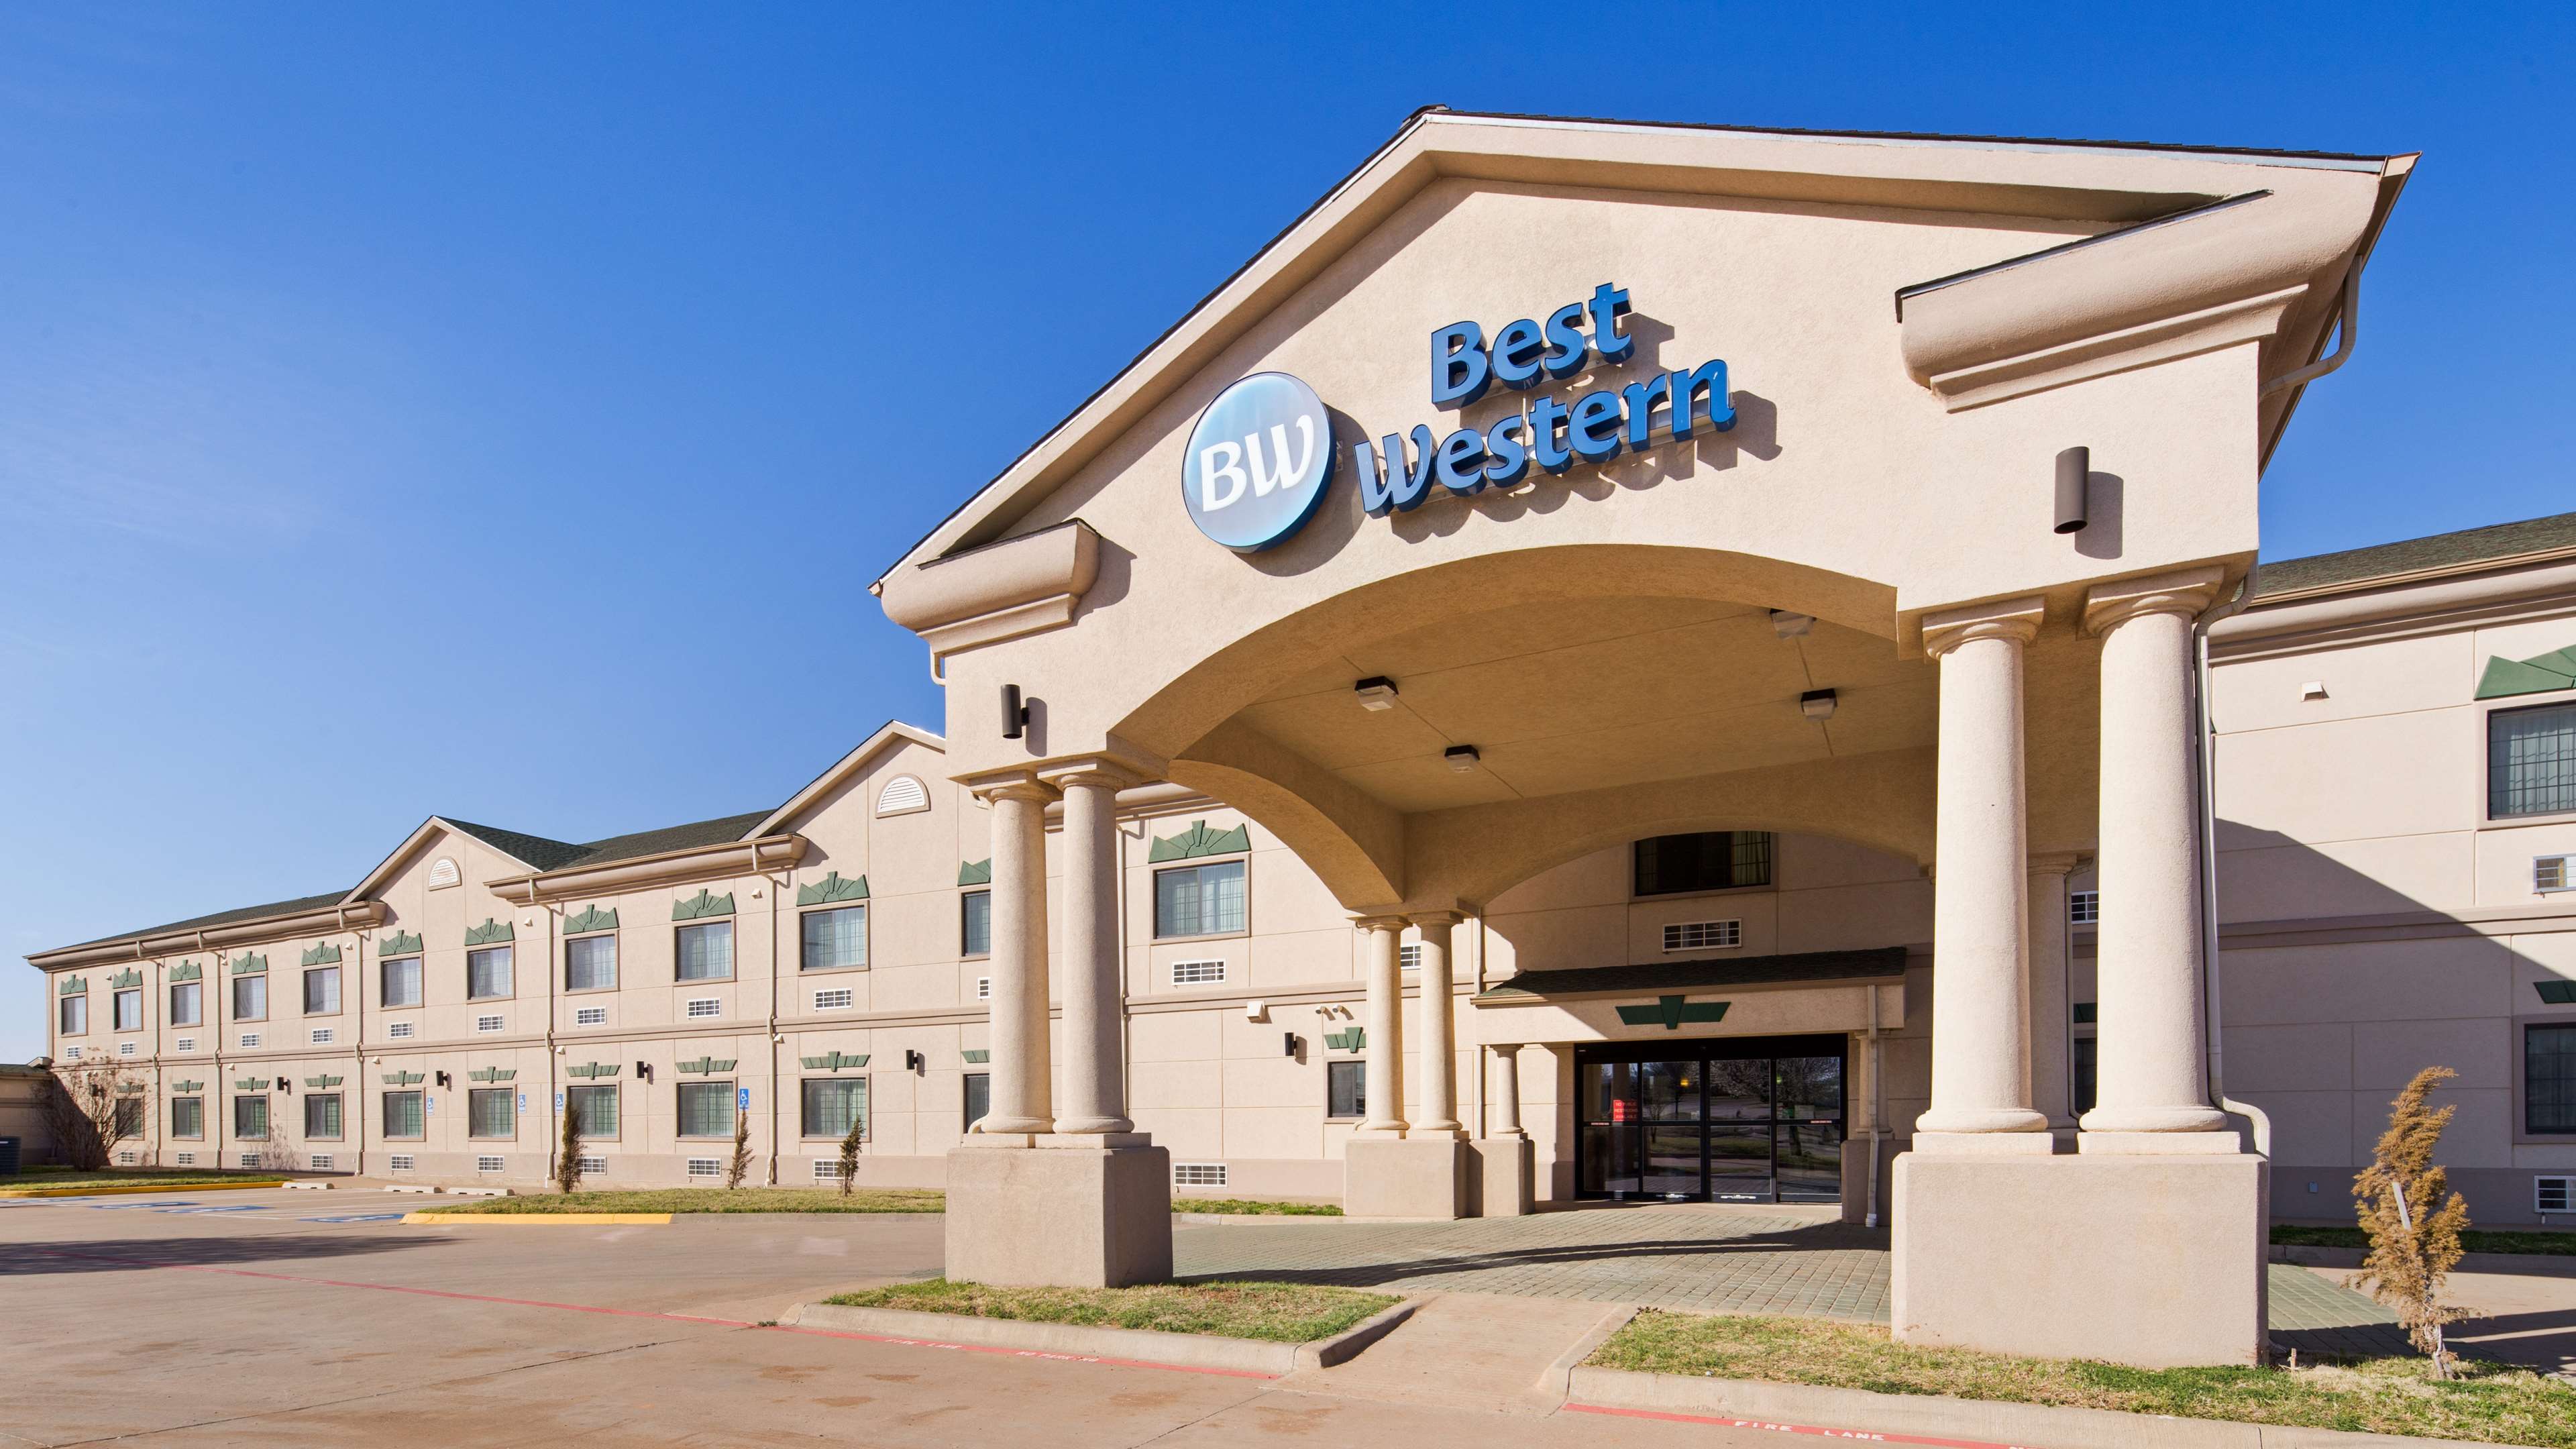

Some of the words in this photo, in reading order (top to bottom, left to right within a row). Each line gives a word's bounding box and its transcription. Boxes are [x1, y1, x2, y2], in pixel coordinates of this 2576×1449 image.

[1432, 282, 1633, 407] Best
[1200, 414, 1314, 512] BW
[1354, 359, 1737, 516] Western
[1735, 1421, 1792, 1432] FIRE
[1823, 1430, 1884, 1440] LANE
